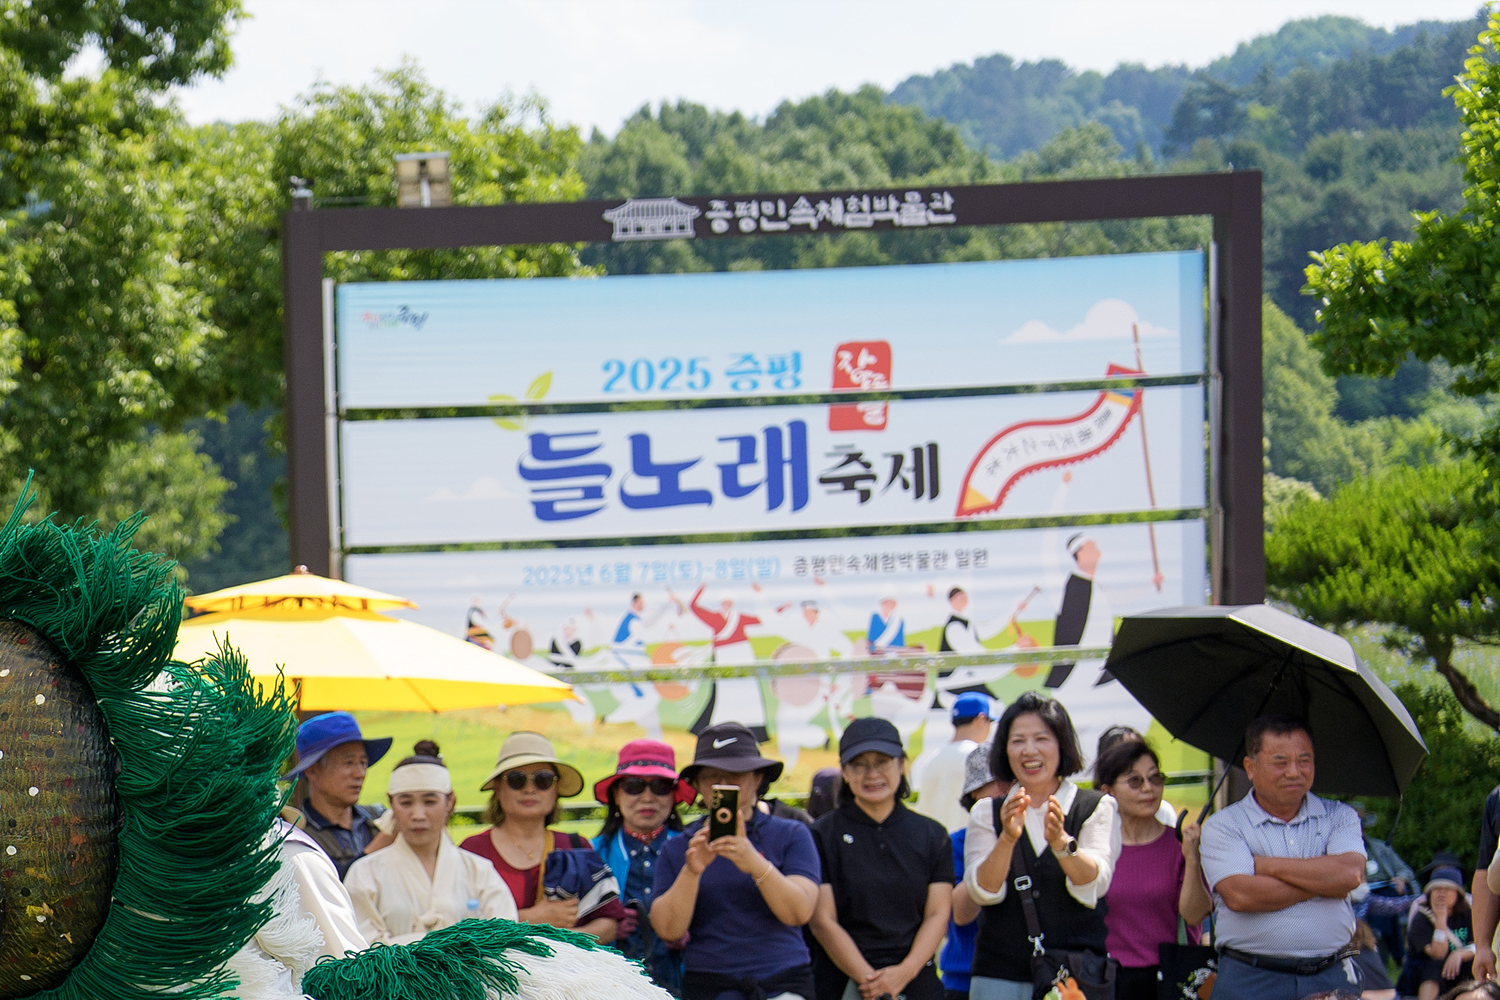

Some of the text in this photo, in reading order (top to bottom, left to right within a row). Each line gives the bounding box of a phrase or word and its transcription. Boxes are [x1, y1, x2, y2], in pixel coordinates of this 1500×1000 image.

[705, 190, 957, 234] 증평민속체험박물관
[602, 350, 801, 393] 2025 증평
[518, 418, 940, 522] 들노래 축제
[522, 564, 594, 586] 2025년
[600, 561, 632, 584] 6월
